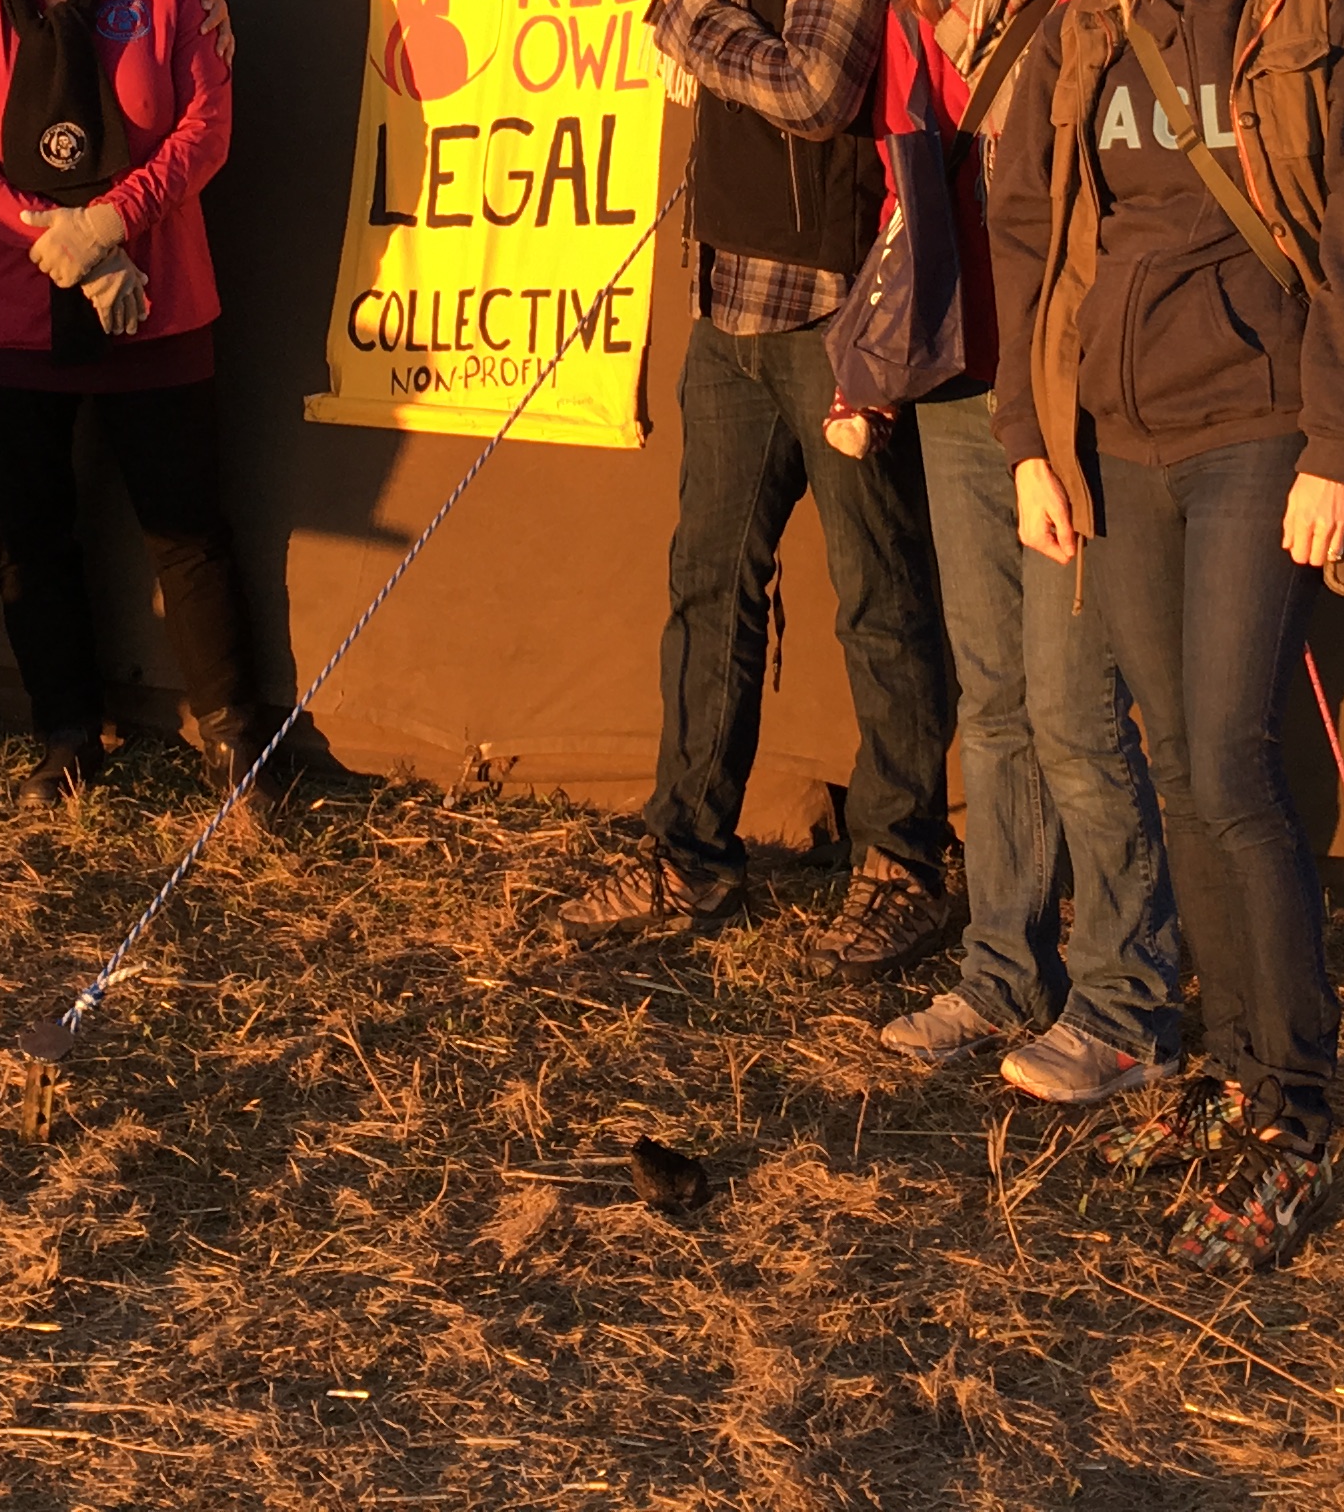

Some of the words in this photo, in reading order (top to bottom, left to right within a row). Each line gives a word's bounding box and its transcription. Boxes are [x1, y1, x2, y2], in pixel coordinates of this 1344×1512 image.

[512, 10, 650, 94] OWL
[1098, 83, 1237, 150] ACL
[367, 113, 637, 229] LEGAL
[346, 286, 635, 354] COLLECTIVE
[389, 354, 565, 396] NON-PROFIT
